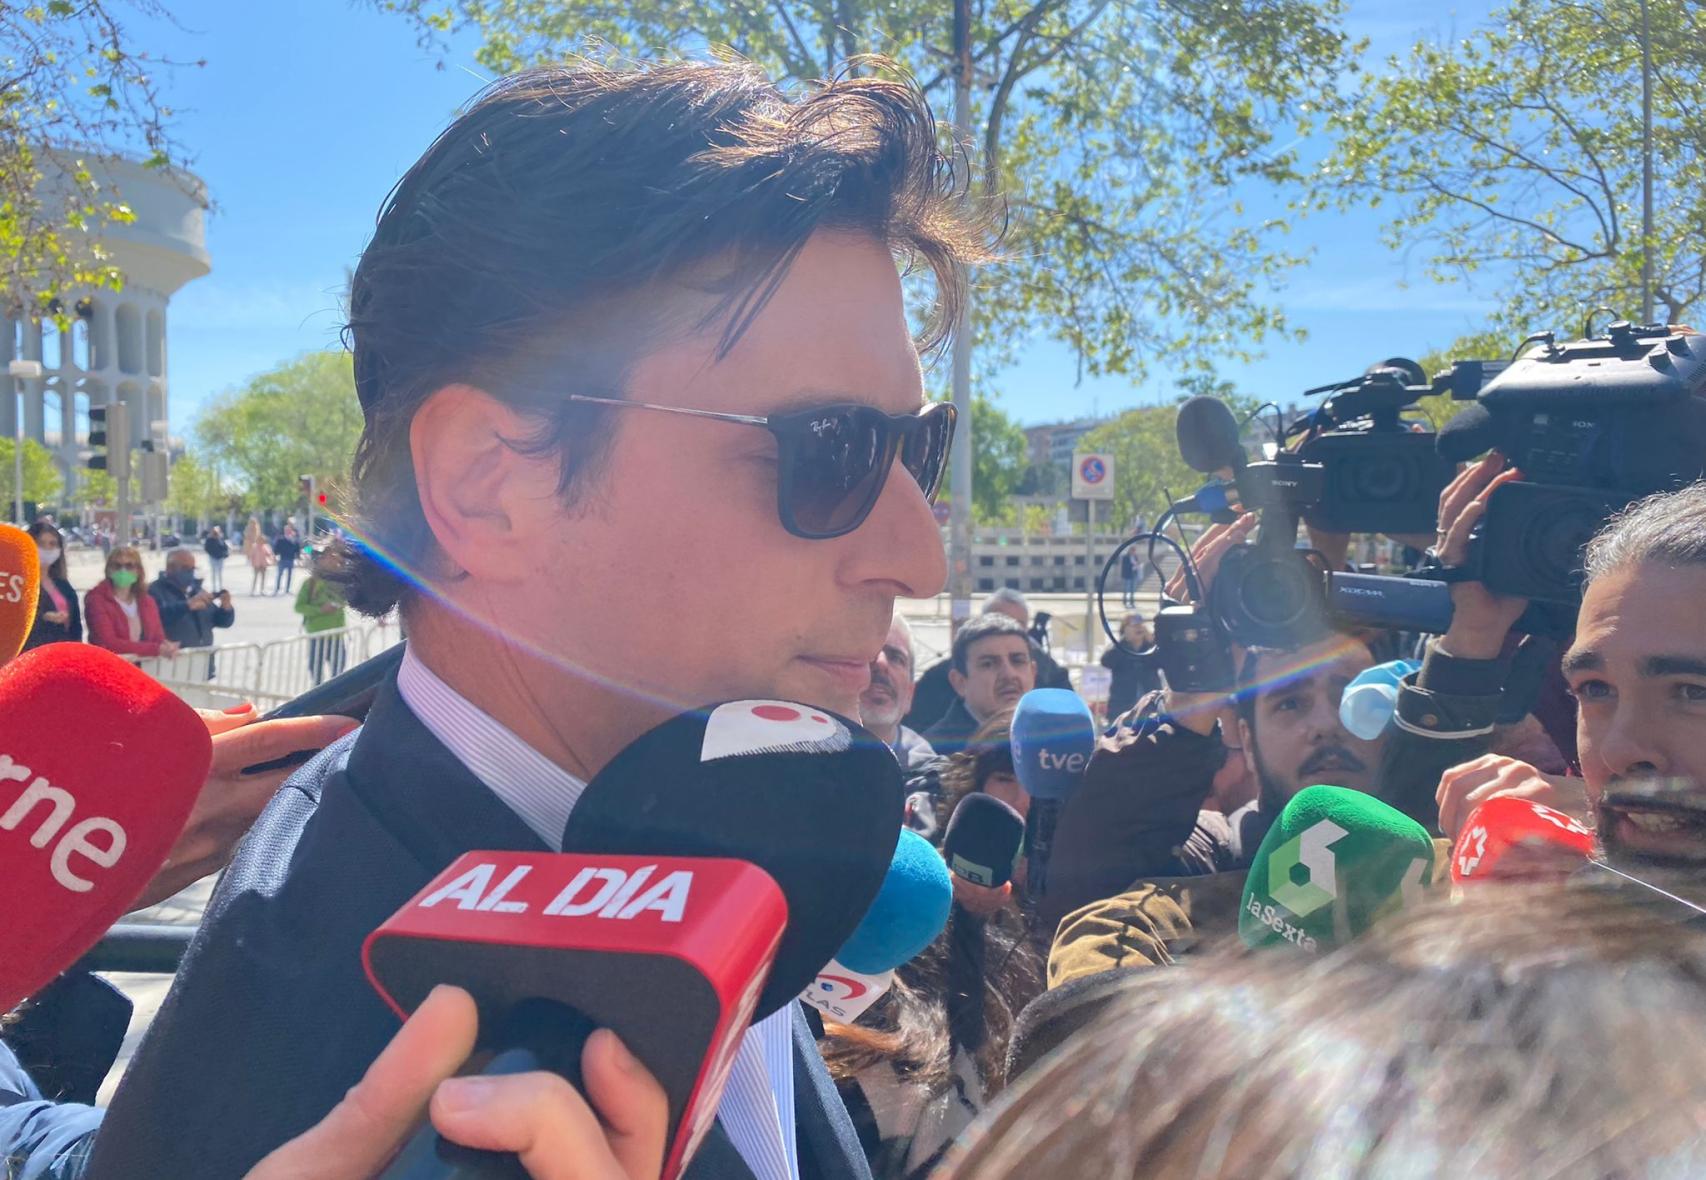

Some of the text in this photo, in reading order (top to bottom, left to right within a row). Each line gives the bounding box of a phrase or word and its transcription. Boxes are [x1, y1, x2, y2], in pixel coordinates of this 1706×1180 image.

[1038, 747, 1085, 773] tve
[418, 863, 533, 913] AL
[1245, 892, 1318, 952] laSexta
